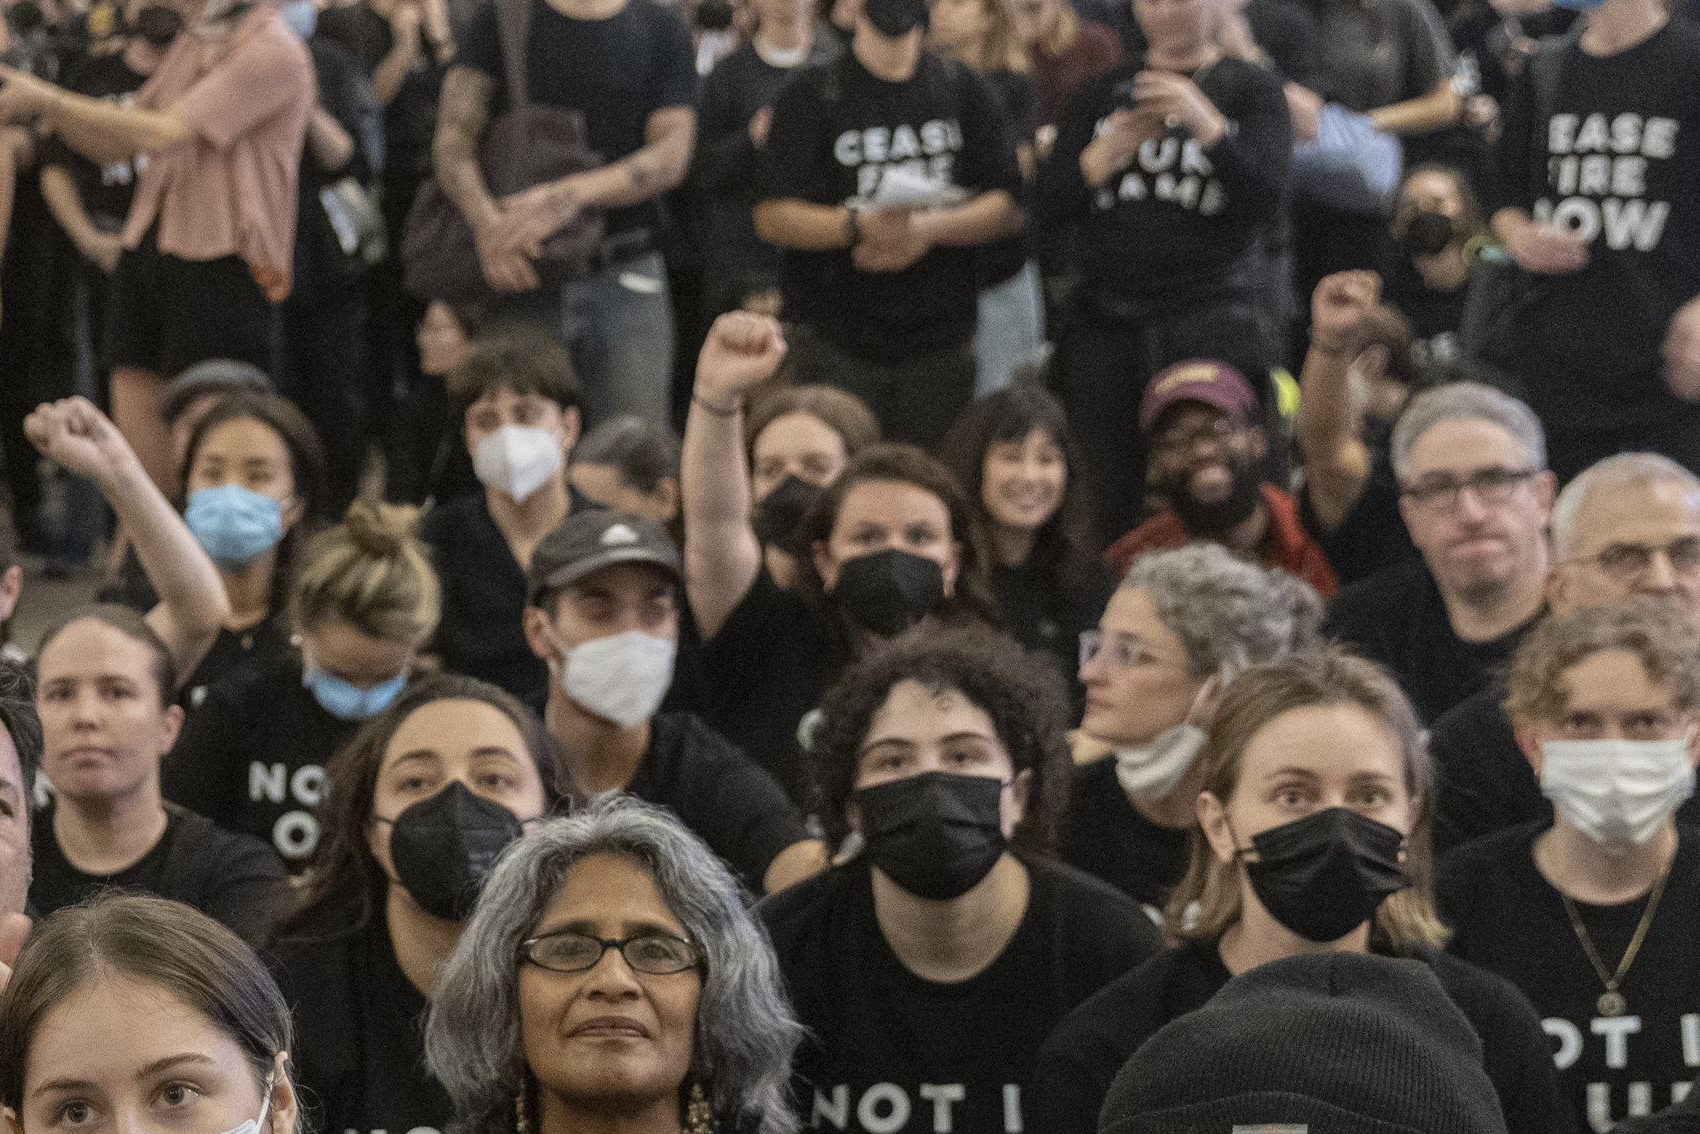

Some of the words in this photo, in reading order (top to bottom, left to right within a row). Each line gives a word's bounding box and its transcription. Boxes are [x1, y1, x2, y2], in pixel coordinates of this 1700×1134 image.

[1549, 112, 1679, 159] EASE
[248, 760, 332, 808] NO
[1540, 1014, 1642, 1070] OT
